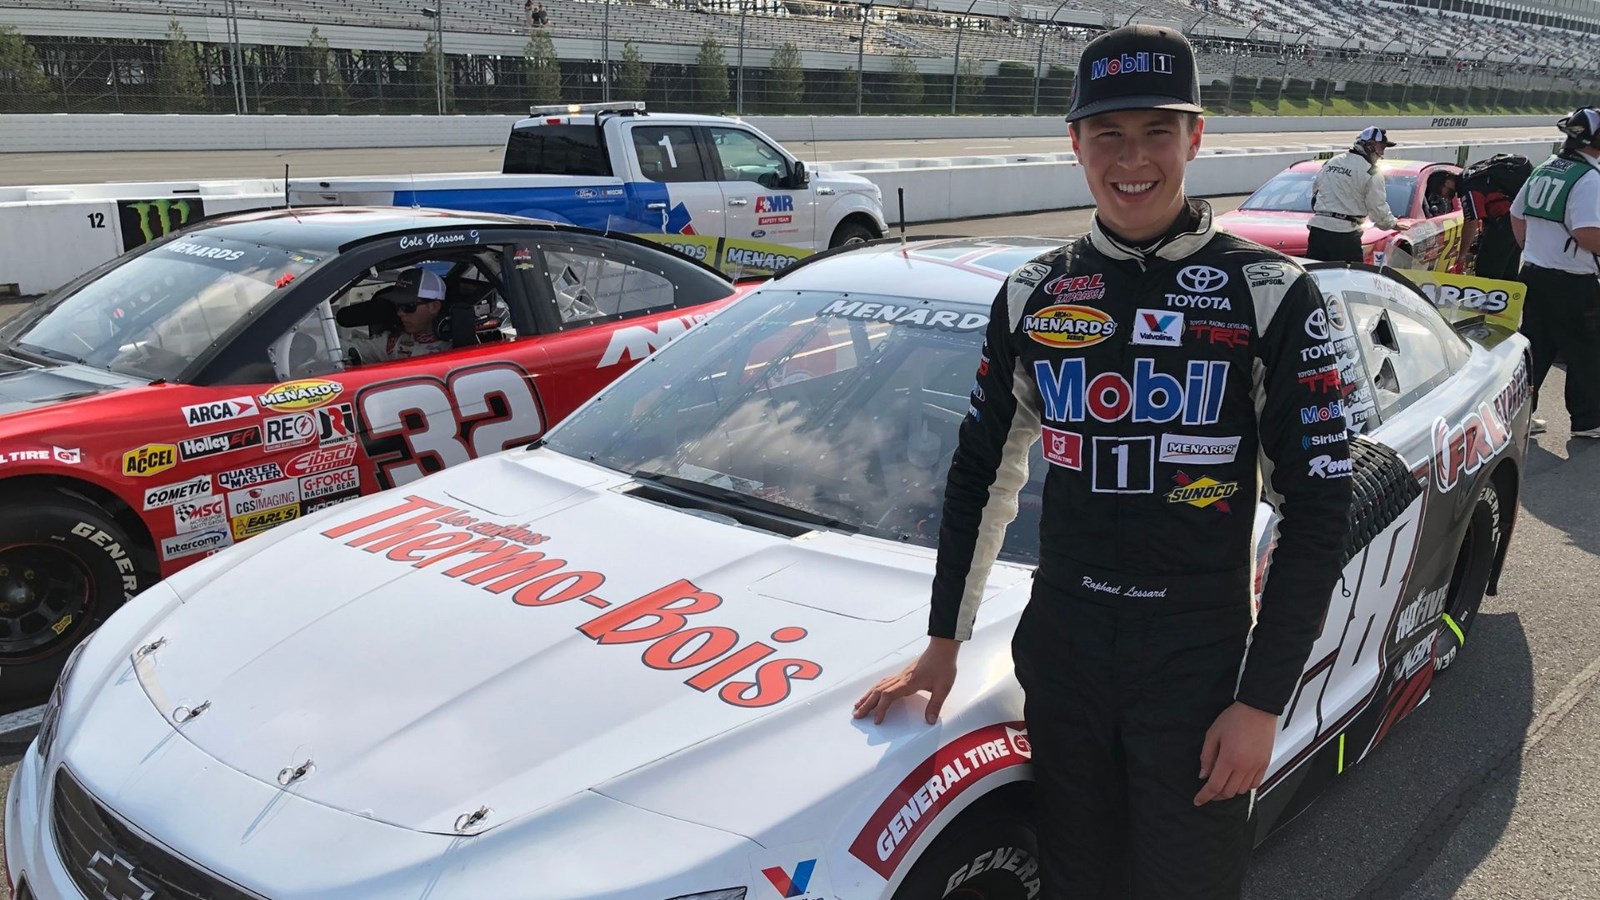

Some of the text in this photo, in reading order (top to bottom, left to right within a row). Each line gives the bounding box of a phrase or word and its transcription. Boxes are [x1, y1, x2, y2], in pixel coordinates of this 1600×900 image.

[1091, 52, 1150, 80] Mobil
[1431, 118, 1469, 127] POCONO
[658, 135, 678, 168] 1
[755, 195, 794, 213] AMR
[87, 212, 105, 229] 12
[165, 241, 245, 261] MENARDS
[400, 236, 424, 249] Cole
[426, 233, 466, 249] Glasson
[1047, 273, 1105, 295] FRL
[1251, 279, 1285, 288] SIMPSON
[1164, 293, 1232, 311] TOYOTA
[1421, 283, 1509, 313] ARDS
[820, 299, 990, 331] MENARD
[1023, 316, 1116, 337] MENARDS
[1140, 332, 1173, 342] Valvoline
[258, 383, 343, 406] MENARDS
[1034, 357, 1231, 425] Mobil
[189, 402, 234, 425] ARCA
[360, 364, 545, 488] 32
[8, 450, 50, 461] TIRE
[183, 436, 230, 455] Holley
[1167, 442, 1233, 455] MENARDS
[126, 452, 173, 474] ACCEL
[1111, 444, 1129, 489] 1
[219, 463, 277, 485] QUARTER
[231, 470, 281, 489] MASTER
[147, 479, 210, 505] COMETIC
[305, 480, 356, 498] RACING GEAR
[1168, 482, 1235, 502] SUNOCO
[189, 500, 223, 519] MSG
[166, 535, 221, 554] Intercomp
[1082, 575, 1168, 598] Raphael Lessard
[320, 494, 823, 708] Thermo-Bois
[876, 762, 971, 862] GENERAL
[964, 737, 1011, 769] TIRE
